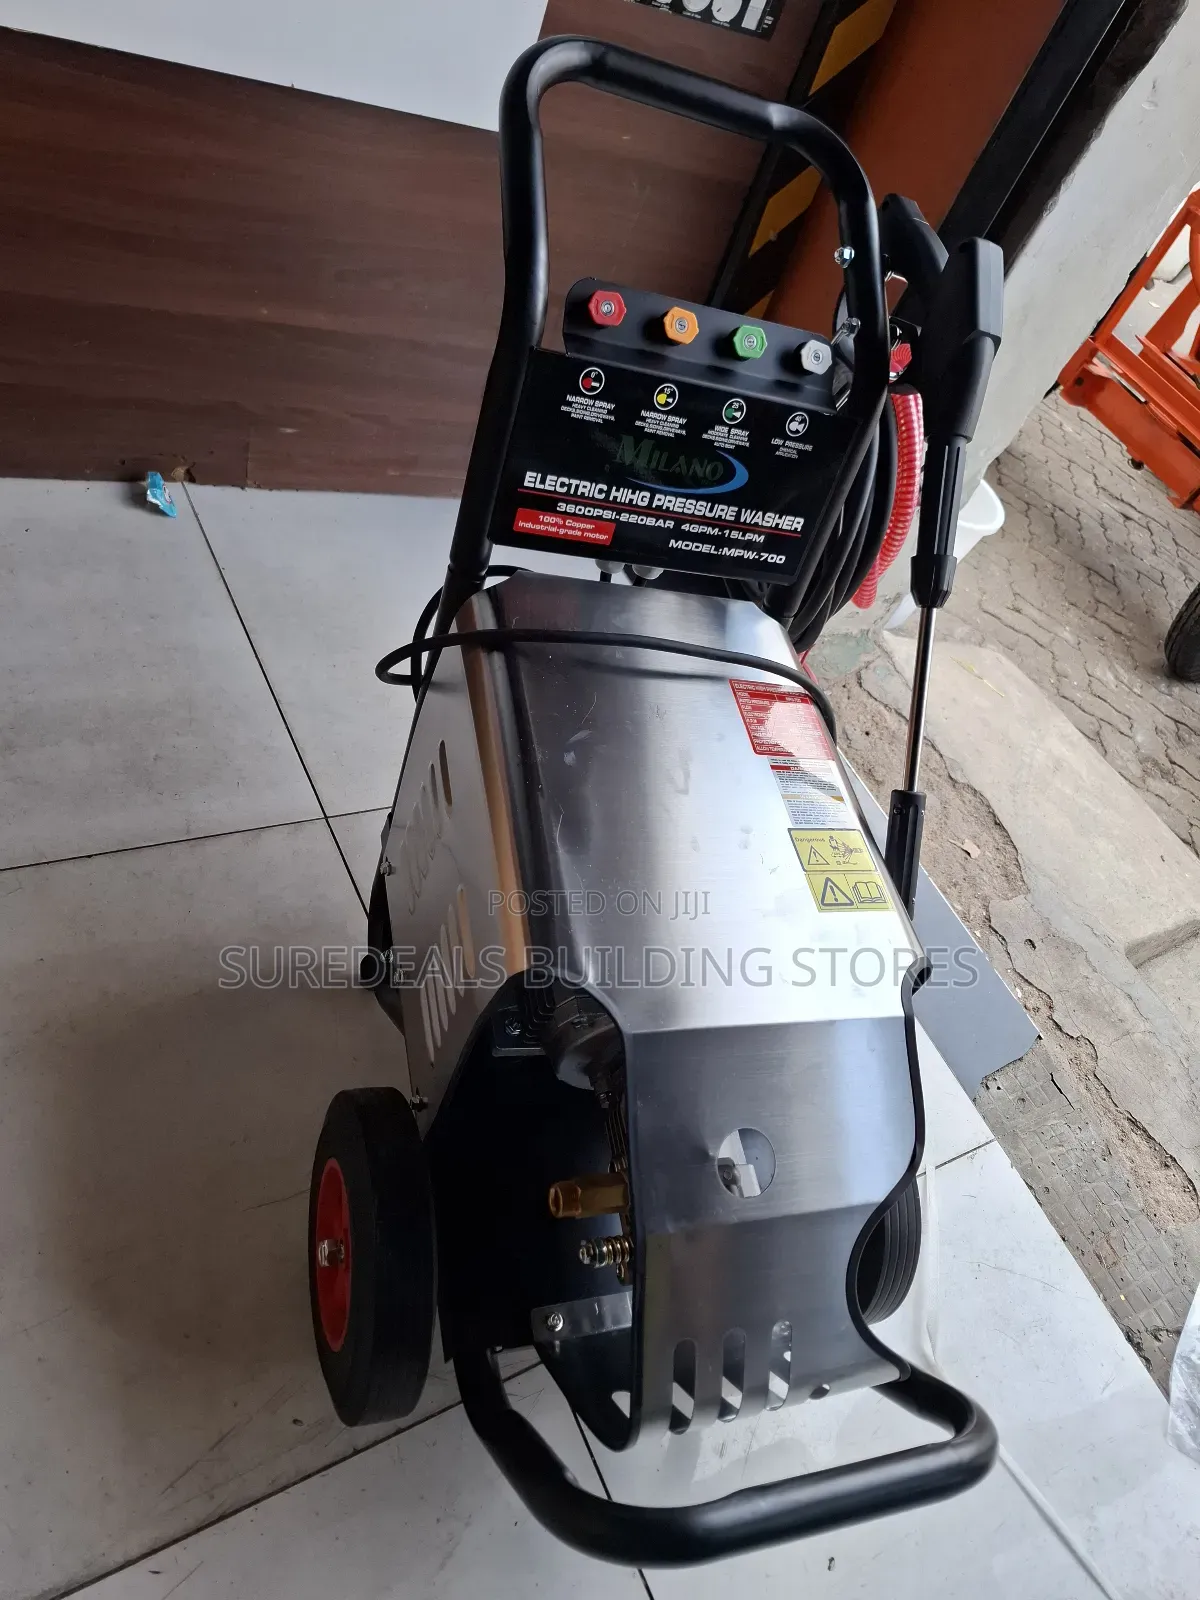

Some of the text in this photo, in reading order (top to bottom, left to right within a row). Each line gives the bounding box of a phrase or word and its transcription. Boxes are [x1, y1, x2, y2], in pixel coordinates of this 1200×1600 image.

[566, 394, 615, 410] NARROW SPRAY
[641, 410, 687, 425] NARROW SPRAY
[714, 425, 750, 437] WIDE SPRAY
[771, 438, 813, 452] LOW PRESSURE
[523, 471, 804, 532] ELECTRIC HIHG PRESSURE WASHER
[518, 520, 608, 540] Industrial-grade motor
[538, 515, 595, 530] 100% Copper
[556, 502, 765, 543] 3600PSI-220BAR 4GPM-15LPM
[668, 539, 786, 564] MODEL:MPW-700
